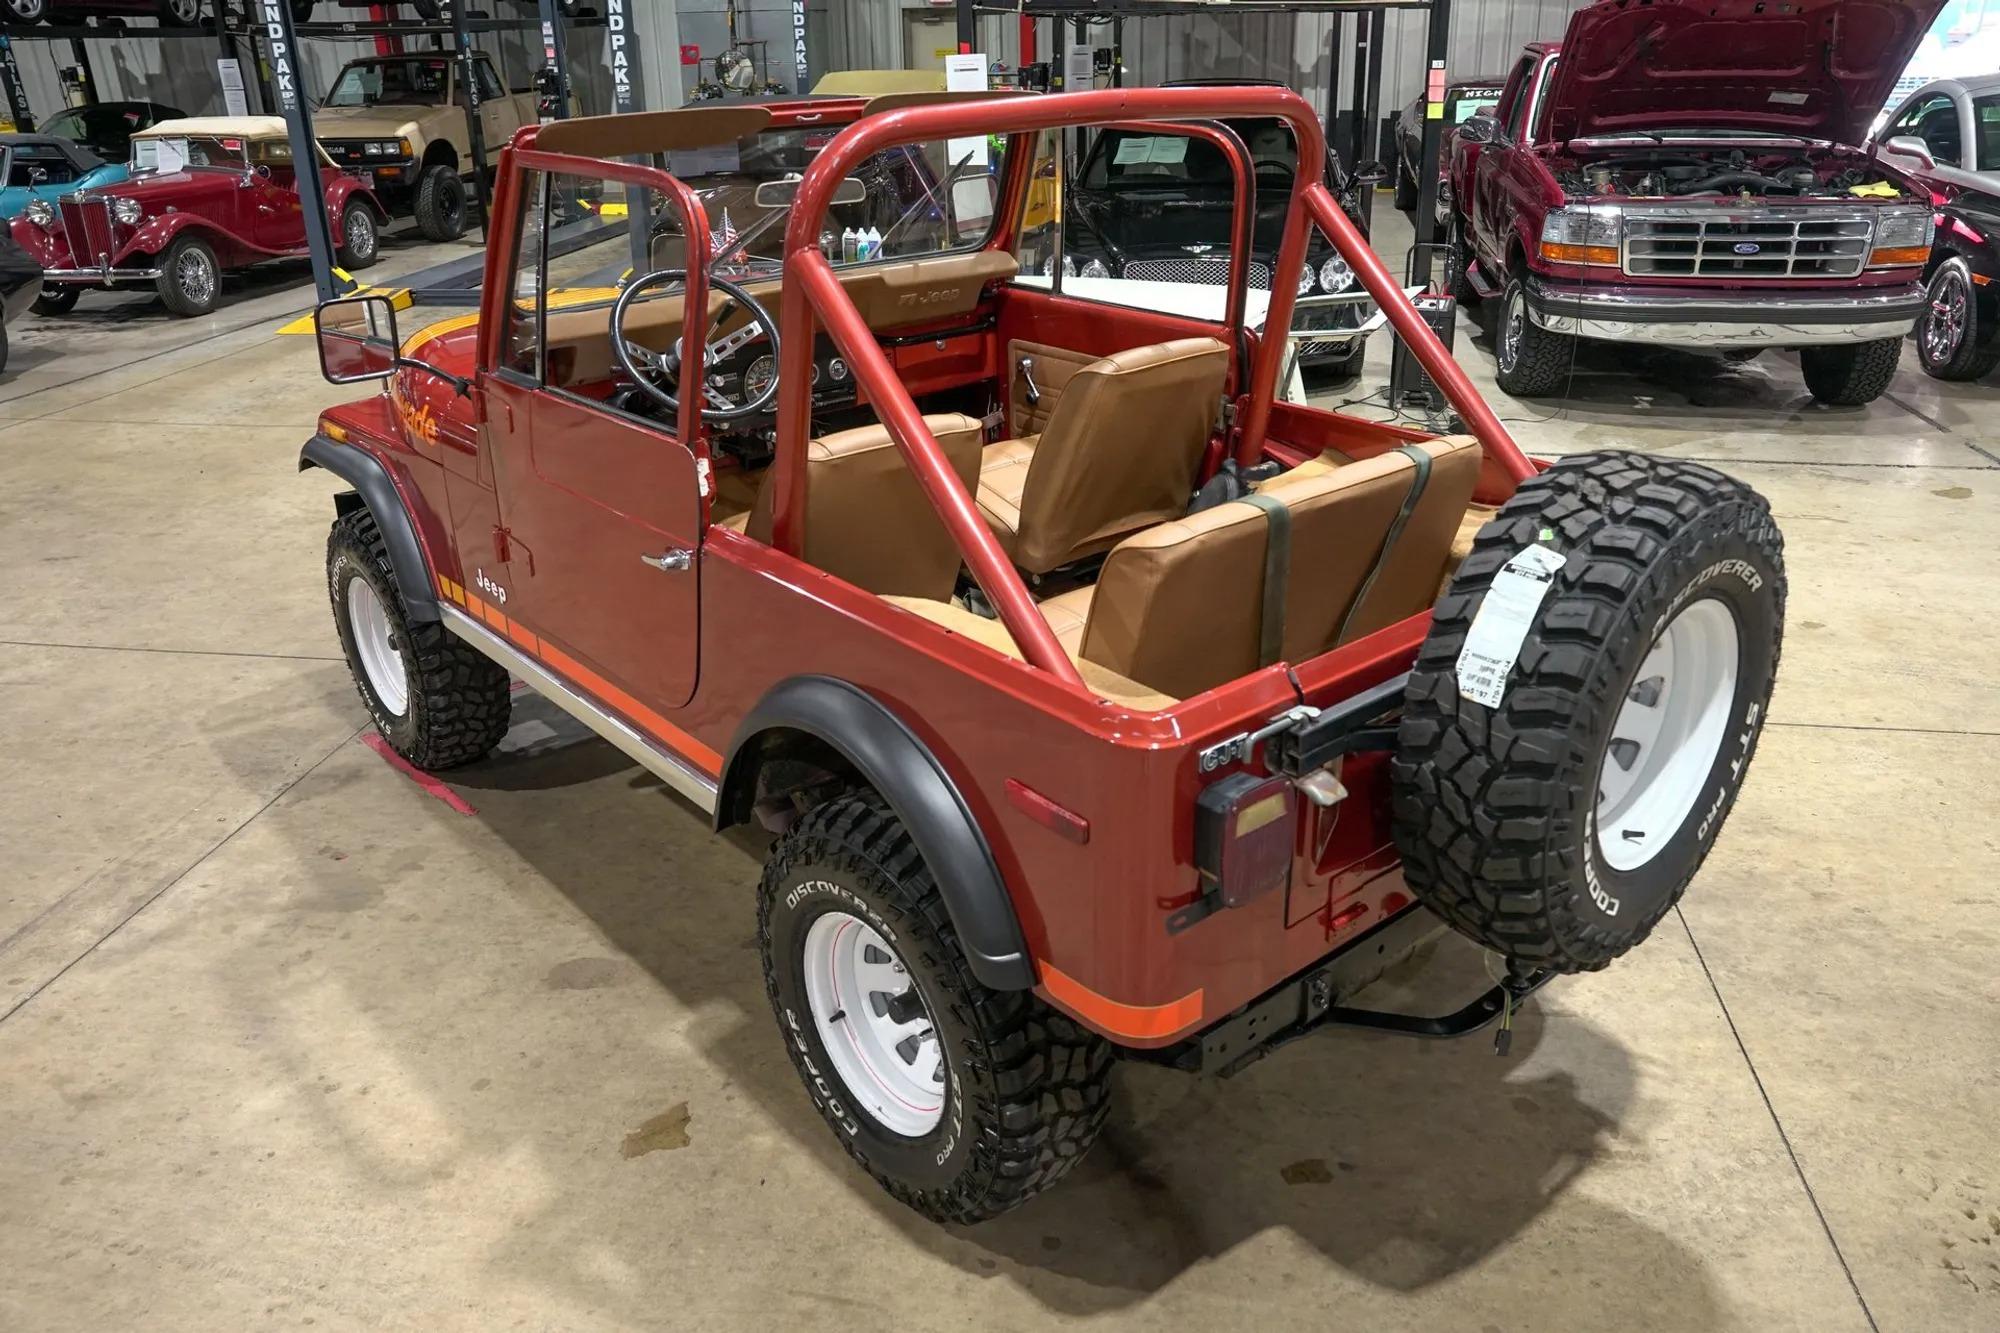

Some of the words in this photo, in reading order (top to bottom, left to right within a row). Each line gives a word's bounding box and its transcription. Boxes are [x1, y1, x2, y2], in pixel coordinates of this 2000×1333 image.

[5, 50, 27, 108] ATLAS
[465, 47, 478, 105] ATLAS
[476, 568, 507, 604] Jeep
[1651, 559, 1763, 642] DISCOVERER
[1731, 701, 1760, 781] STT
[1697, 786, 1726, 840] PRO
[1584, 811, 1620, 916] COOPER
[786, 880, 897, 942] DISCOVERER
[786, 1008, 858, 1136] COOPER
[936, 1134, 955, 1166] PRO
